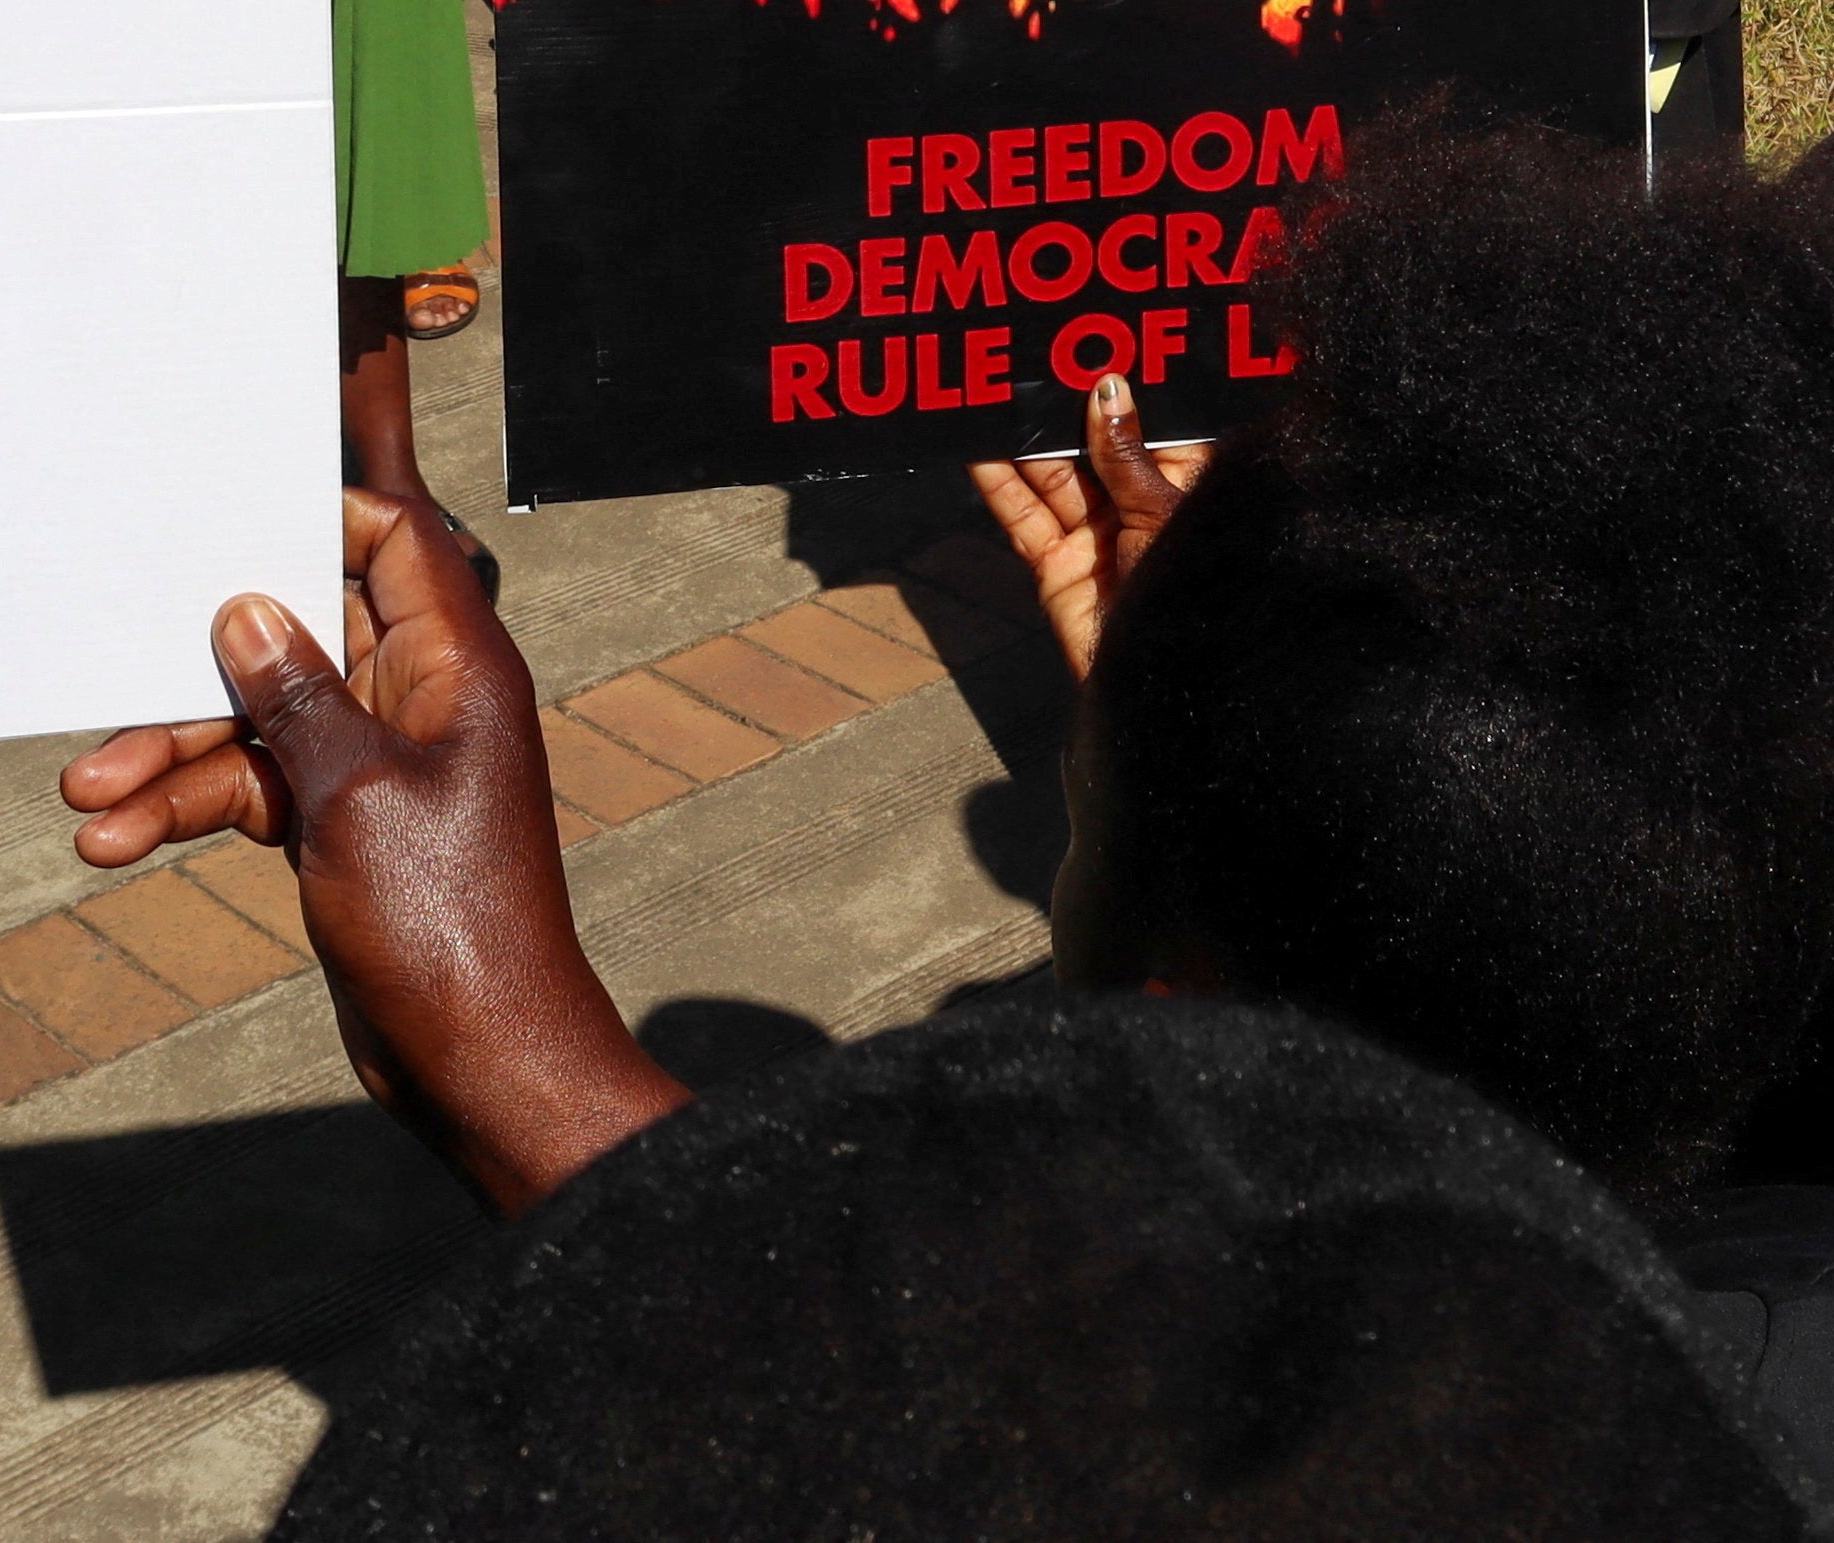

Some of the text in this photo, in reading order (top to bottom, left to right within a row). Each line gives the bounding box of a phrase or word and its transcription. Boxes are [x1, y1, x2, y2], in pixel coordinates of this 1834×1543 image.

[866, 104, 1346, 218] FREEDOM
[783, 206, 1302, 324] DEMOCRA
[770, 326, 1013, 423] RULE
[1050, 307, 1189, 402] OF
